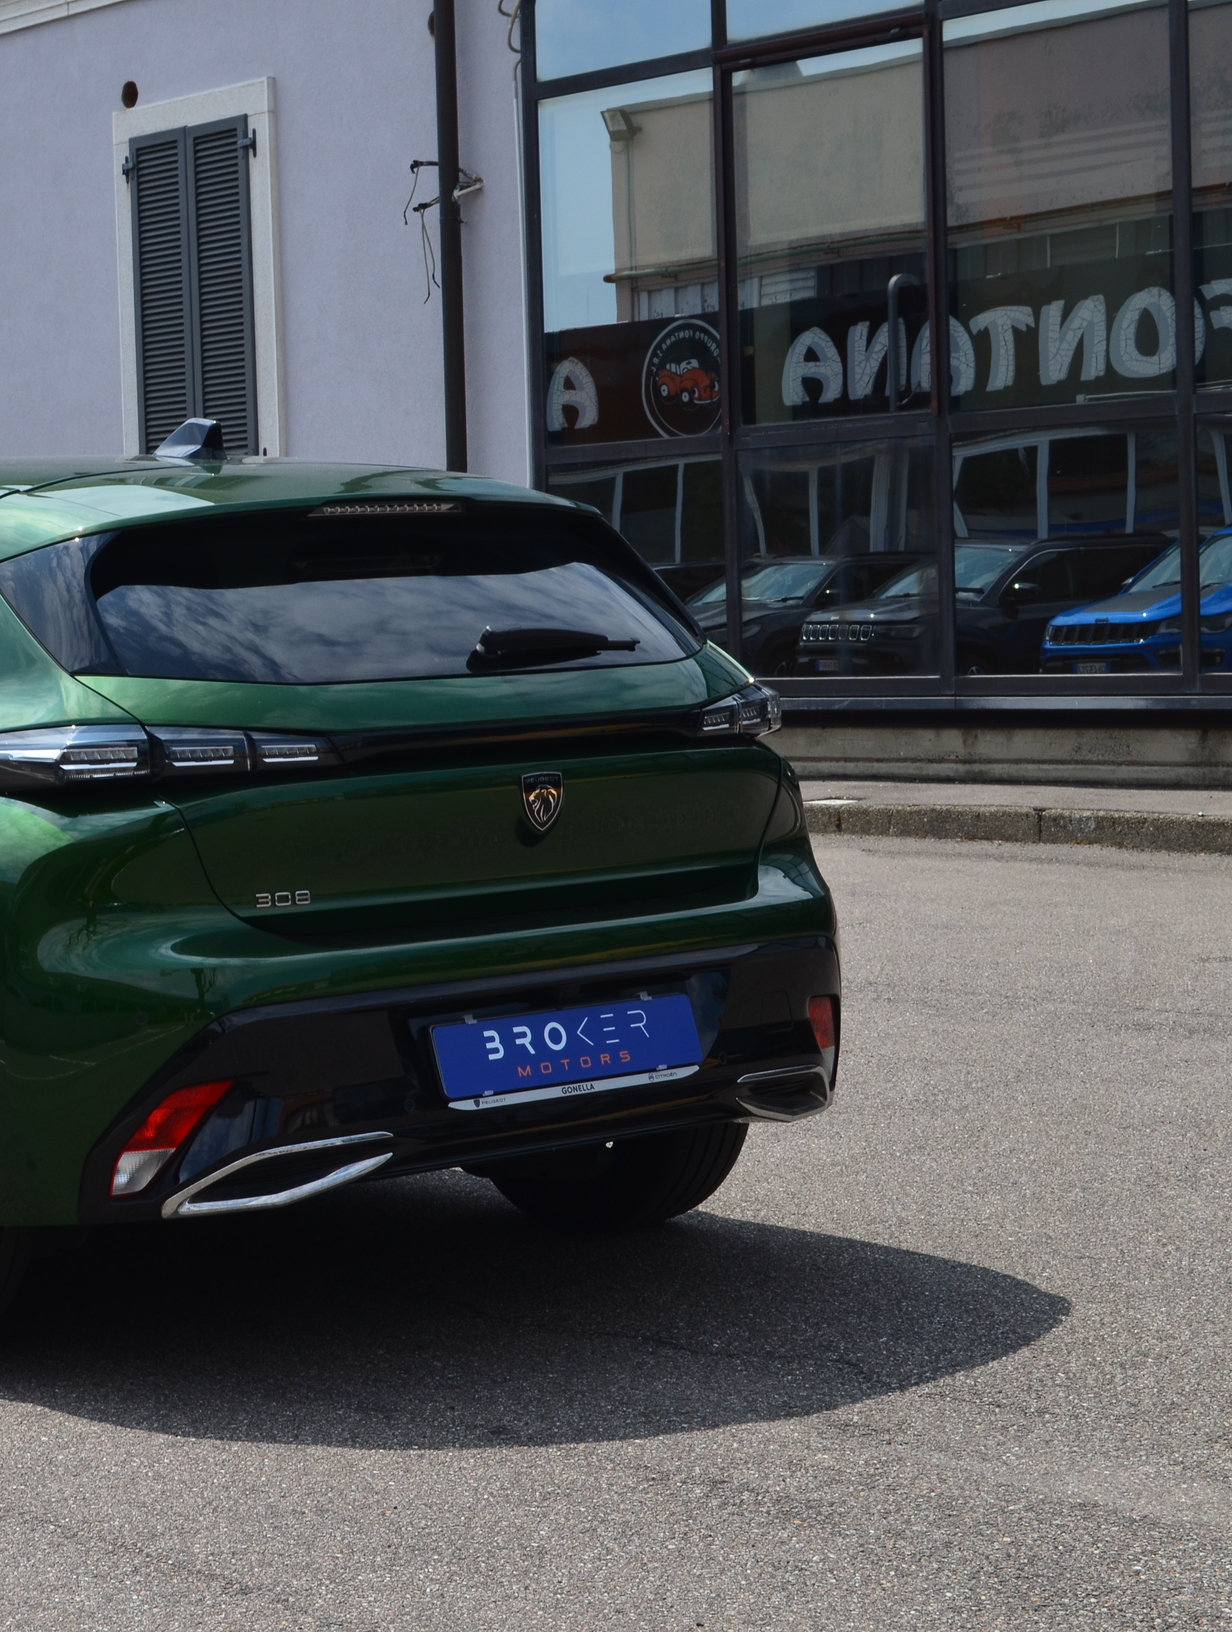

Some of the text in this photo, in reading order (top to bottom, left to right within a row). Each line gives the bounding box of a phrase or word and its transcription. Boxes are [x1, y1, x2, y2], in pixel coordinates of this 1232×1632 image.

[525, 776, 559, 784] PEUGEOT
[255, 890, 311, 908] 308
[483, 1009, 650, 1061] BROKER
[517, 1051, 631, 1077] MOTORS
[481, 1097, 506, 1105] PEUGEOT
[561, 1083, 596, 1095] GONELLA
